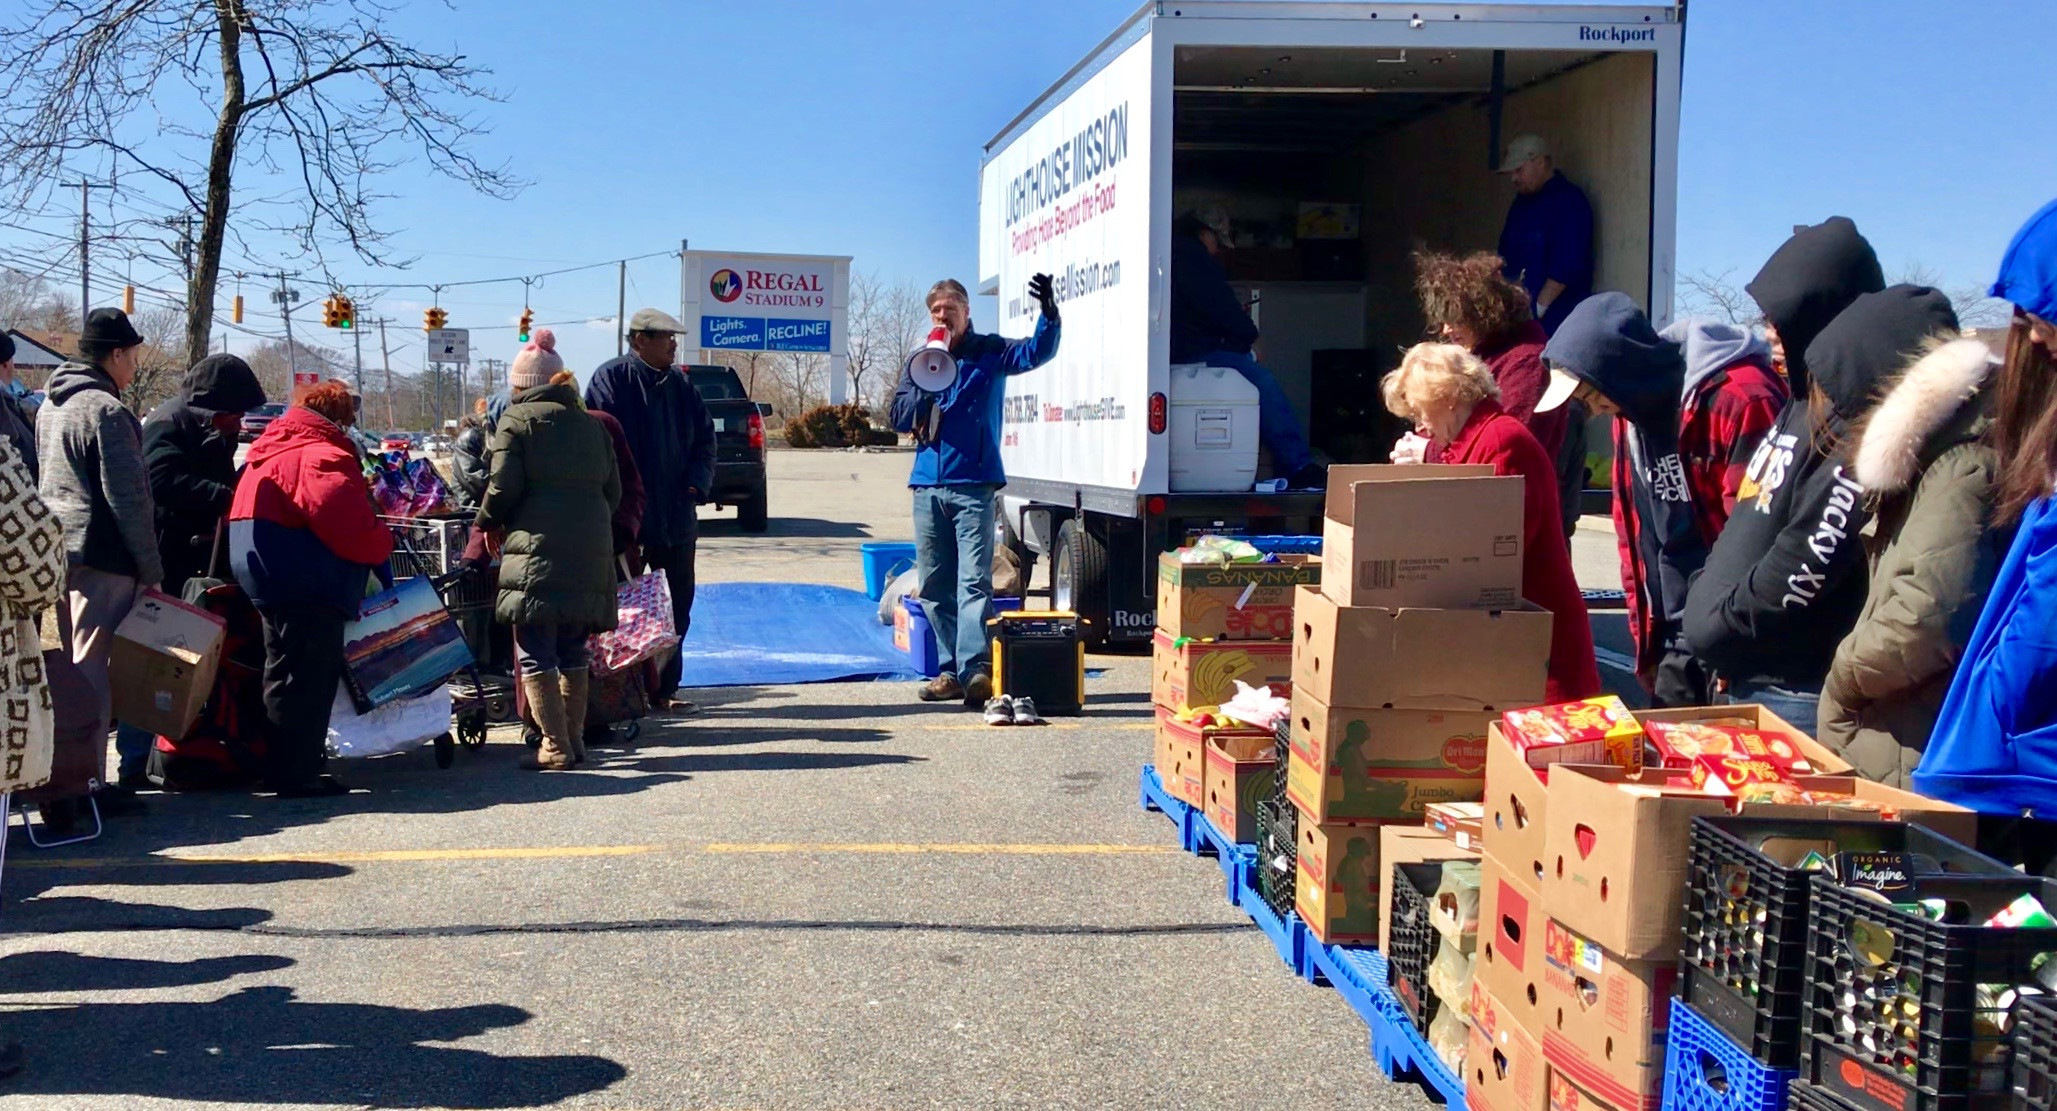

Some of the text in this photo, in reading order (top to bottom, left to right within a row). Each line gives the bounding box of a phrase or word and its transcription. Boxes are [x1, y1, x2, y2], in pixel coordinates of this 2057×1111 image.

[1579, 25, 1656, 44] Rockport
[1005, 99, 1129, 229] LIGHTHOUSE MISSION
[1011, 173, 1117, 258] Providing Hope Beyond the Food
[746, 270, 824, 292] REGAL
[745, 292, 824, 308] STADIUM 9
[768, 321, 827, 341] RECLINE!
[1807, 465, 1865, 565] Jacky
[1206, 570, 1311, 584] BANANAS
[1225, 611, 1294, 637] Dole
[1462, 746, 1485, 758] Mon
[1721, 757, 1774, 785] Stove
[1411, 785, 1454, 800] Jumbo
[1852, 855, 1902, 864] ORGANIC
[1545, 919, 1576, 967] Dole
[1471, 981, 1496, 1036] Dole
